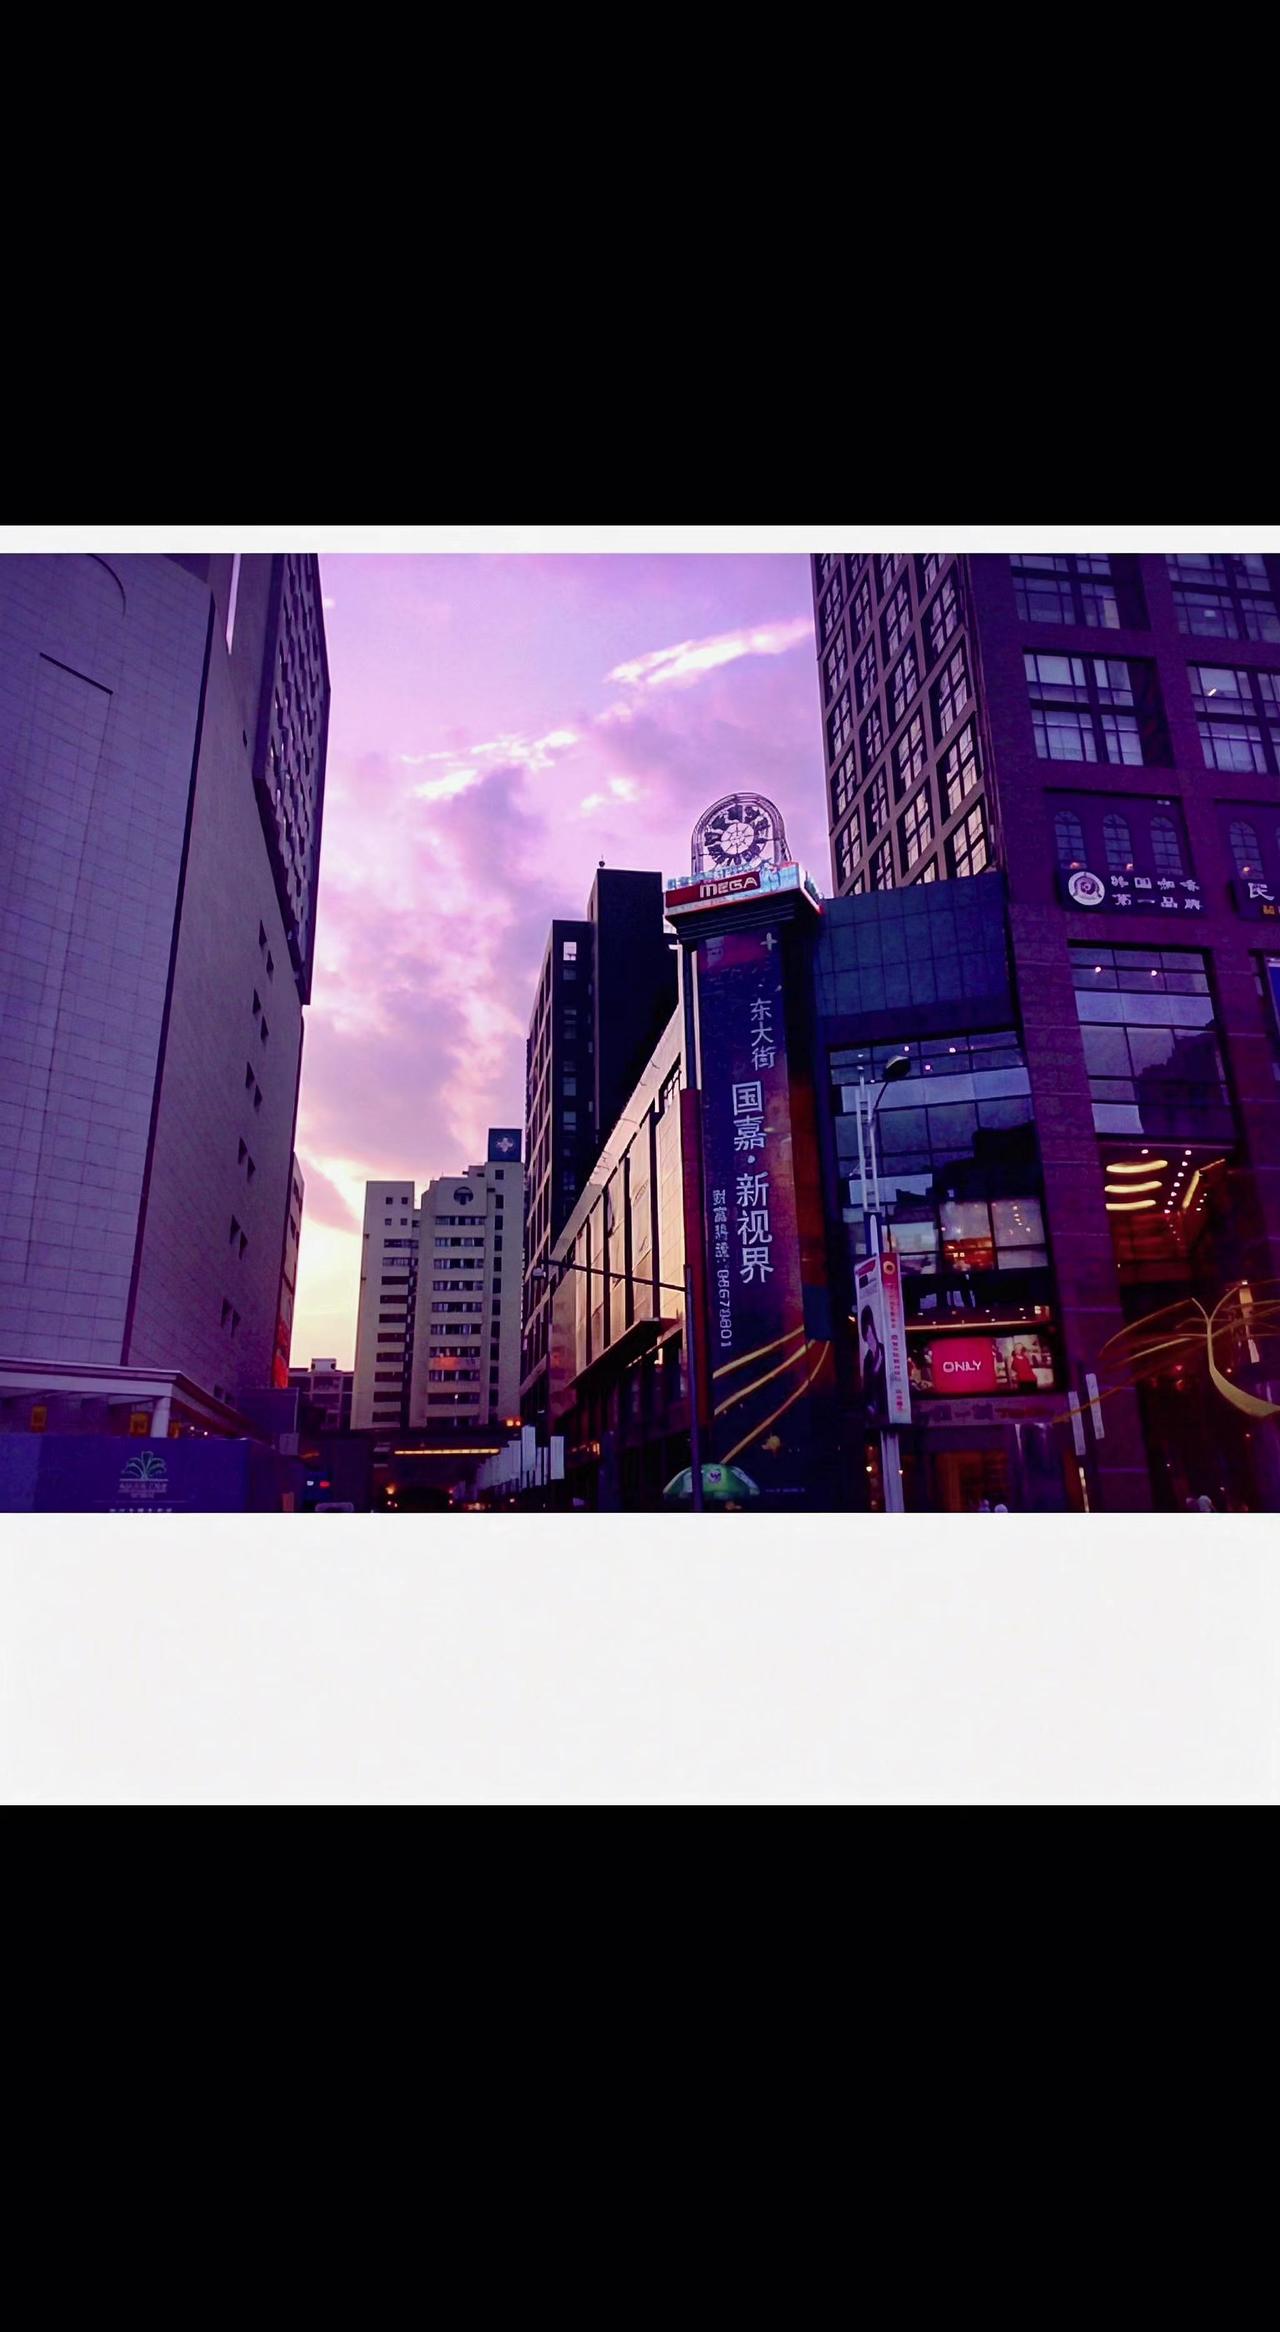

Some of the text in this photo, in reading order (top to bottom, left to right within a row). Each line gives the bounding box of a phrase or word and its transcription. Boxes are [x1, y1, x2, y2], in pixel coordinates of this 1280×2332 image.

[699, 876, 758, 898] MEGA
[1247, 882, 1275, 901] 民
[750, 997, 777, 1071] 东大街
[942, 1360, 982, 1373] ONLY
